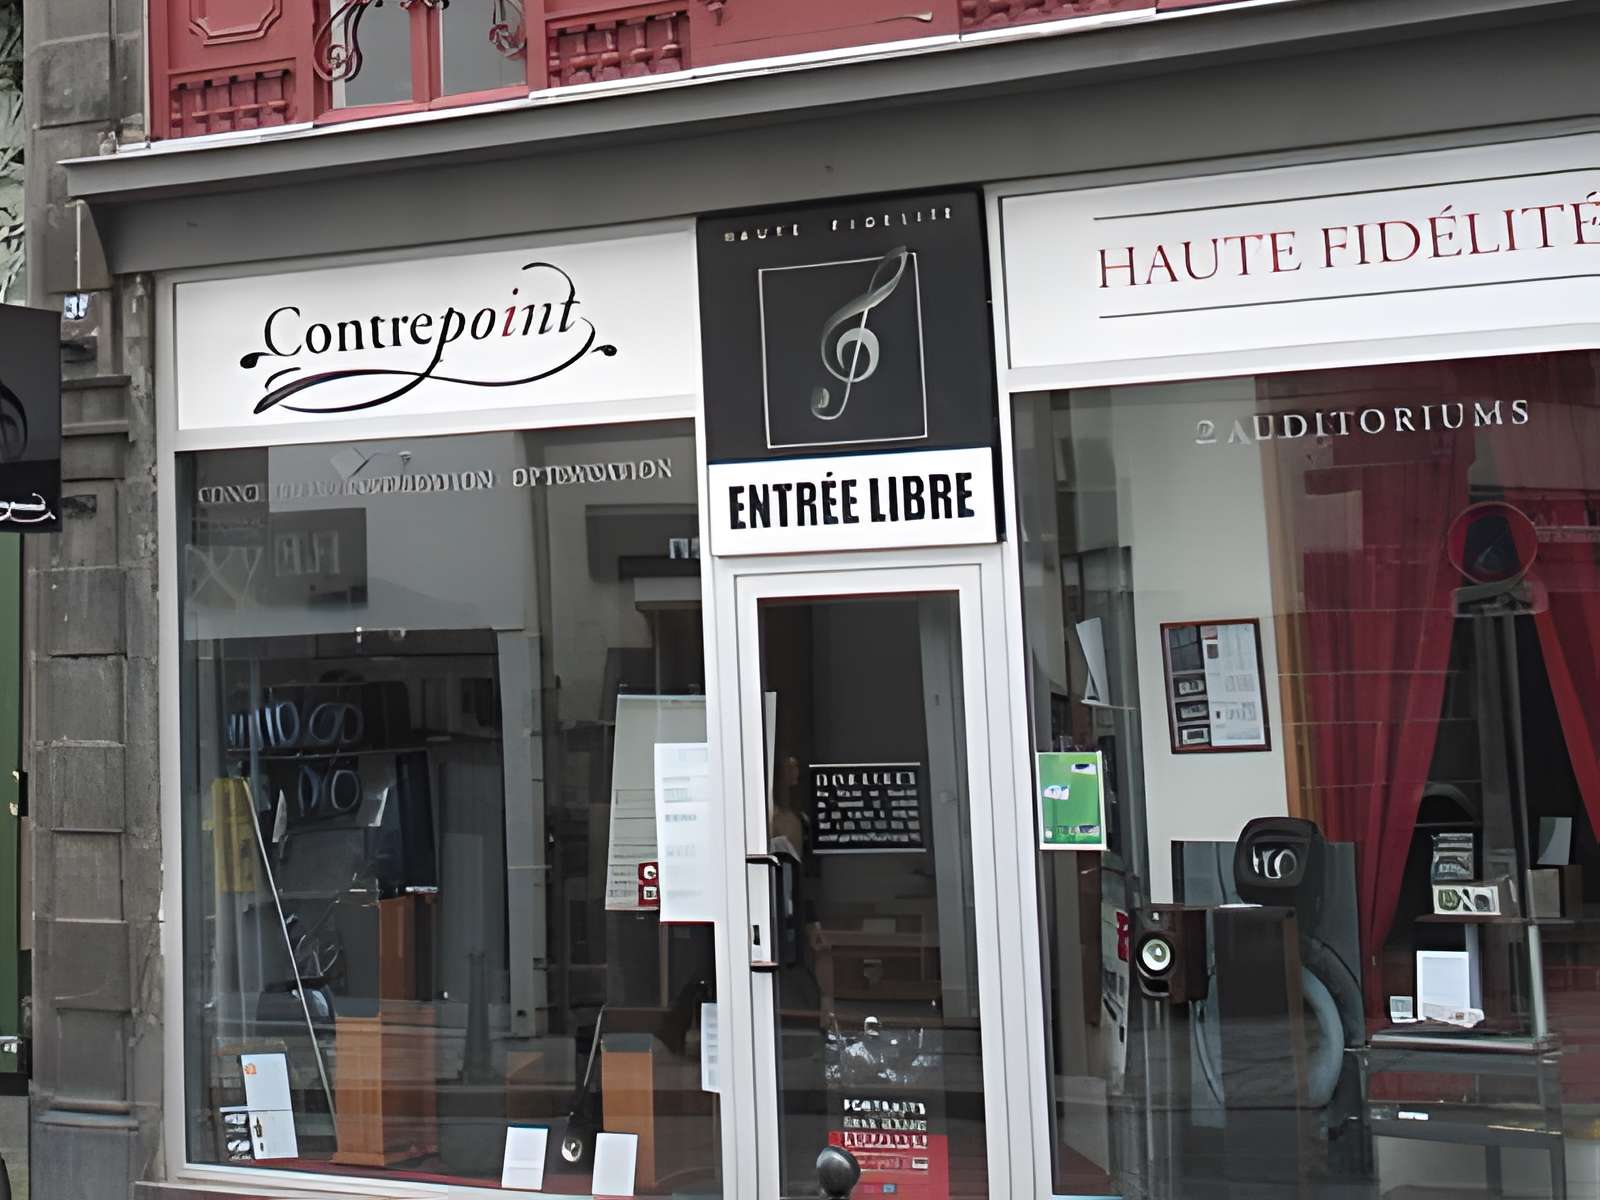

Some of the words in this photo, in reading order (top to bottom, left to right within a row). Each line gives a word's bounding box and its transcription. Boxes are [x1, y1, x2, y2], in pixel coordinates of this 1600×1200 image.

[1099, 231, 1302, 289] HAUTE
[1320, 191, 1600, 270] FIDÉLITÉ
[242, 263, 600, 380] Contrepoint
[1227, 399, 1529, 445] AUDITORIUMS
[728, 471, 860, 530] ENTRÉE
[868, 472, 976, 523] LIBRE
